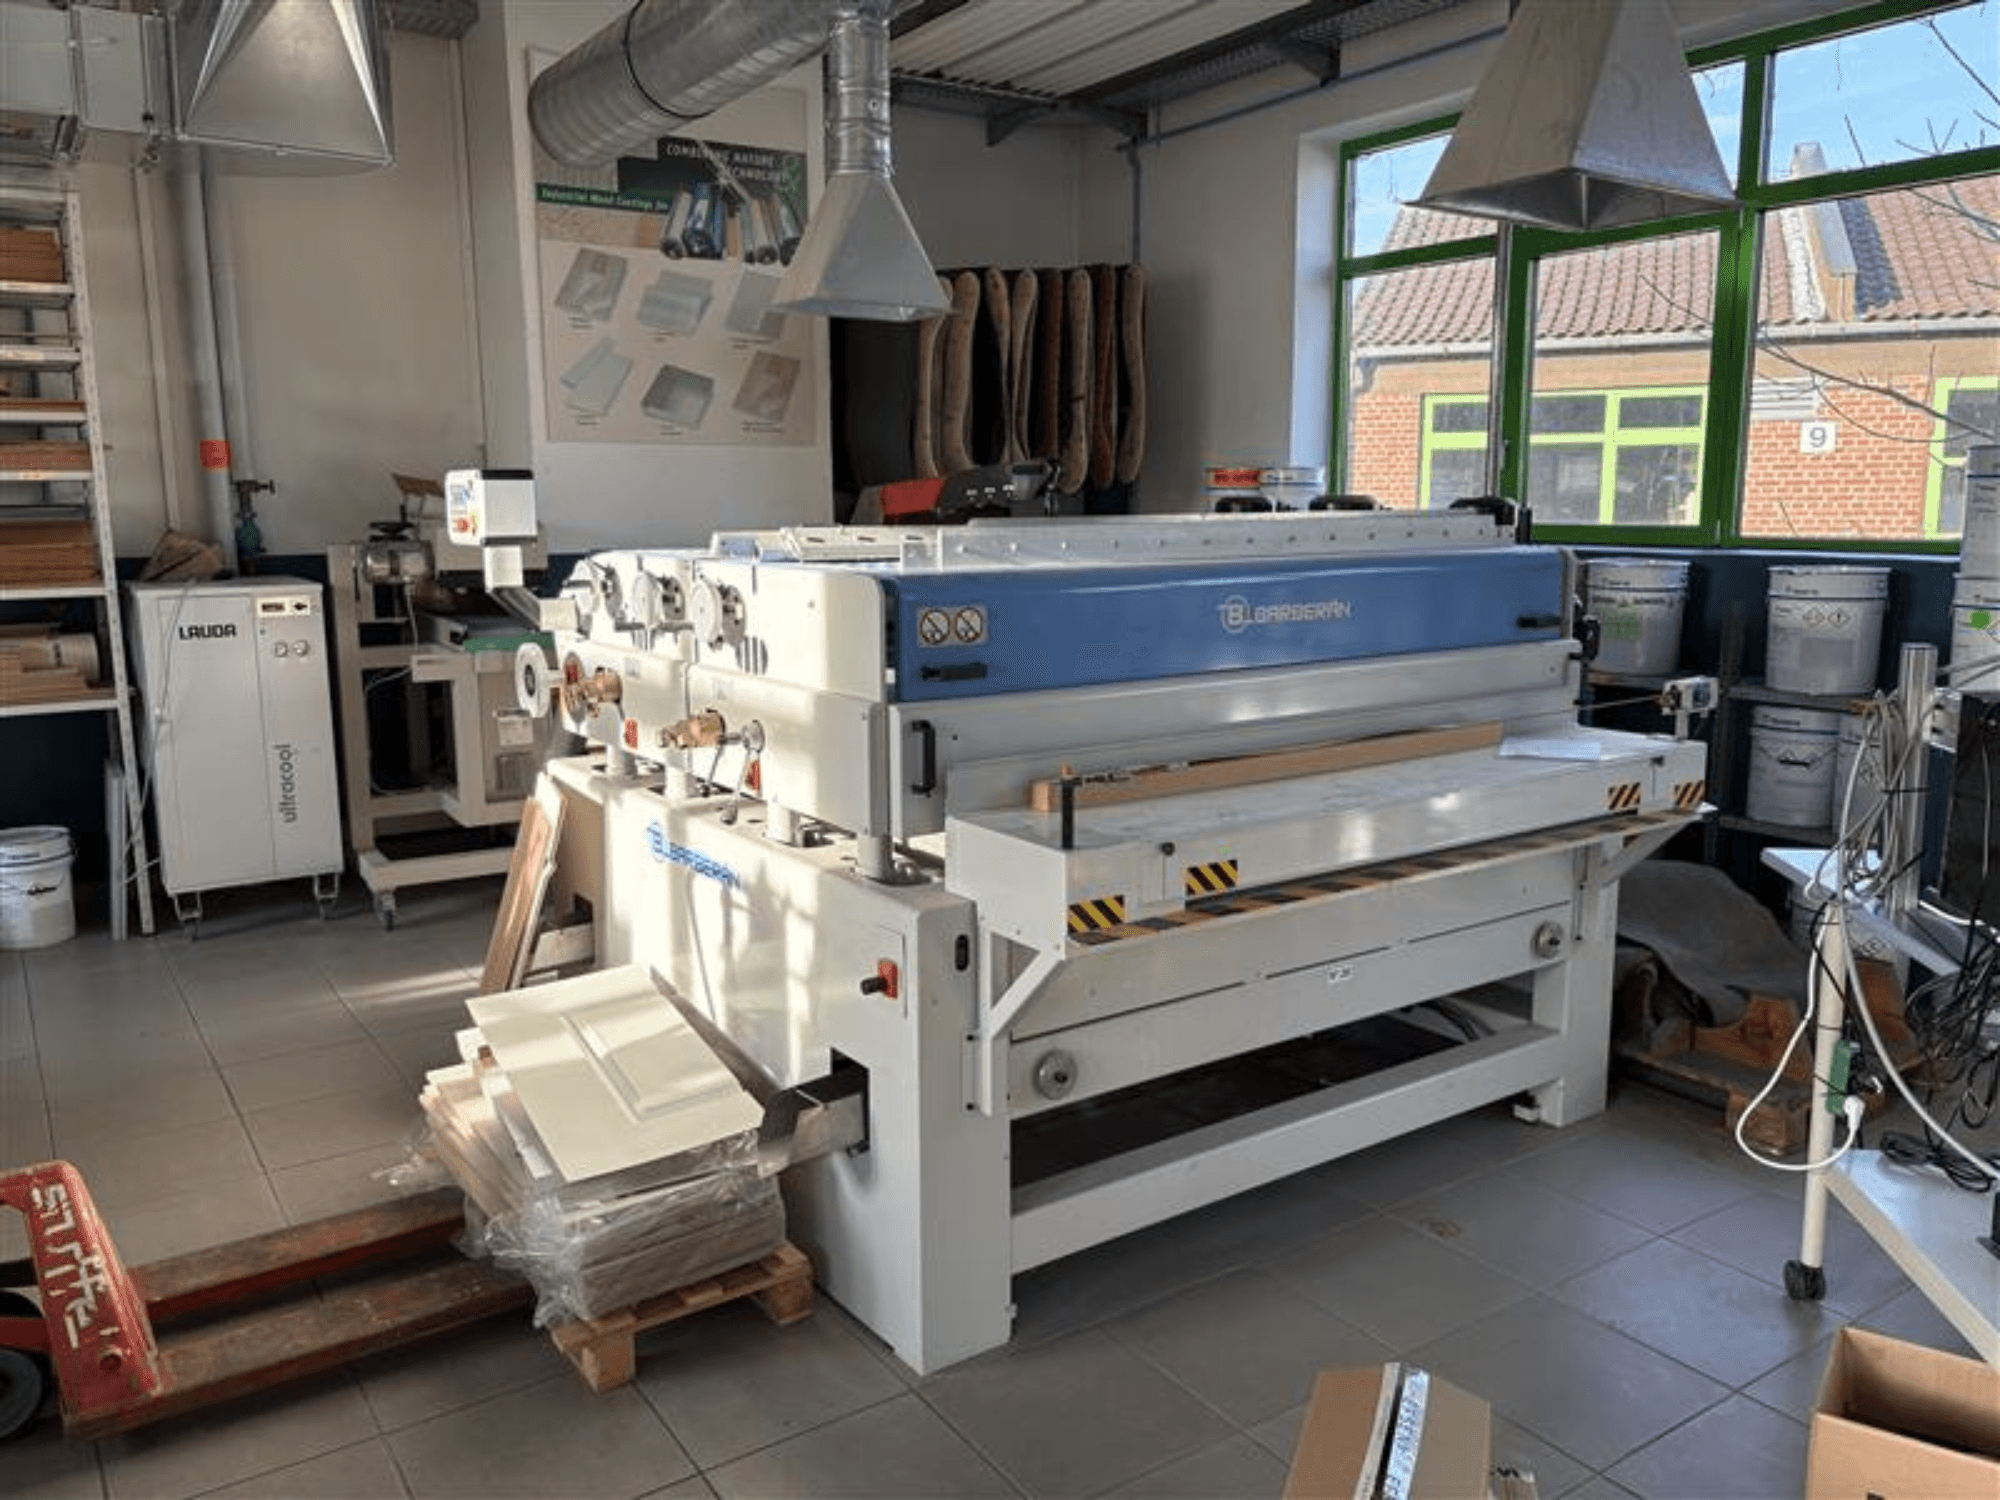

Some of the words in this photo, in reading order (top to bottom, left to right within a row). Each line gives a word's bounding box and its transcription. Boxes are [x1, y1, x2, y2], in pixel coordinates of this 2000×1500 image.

[1810, 427, 1826, 448] 9
[179, 624, 237, 640] LAUDA
[274, 744, 298, 823] ultracool
